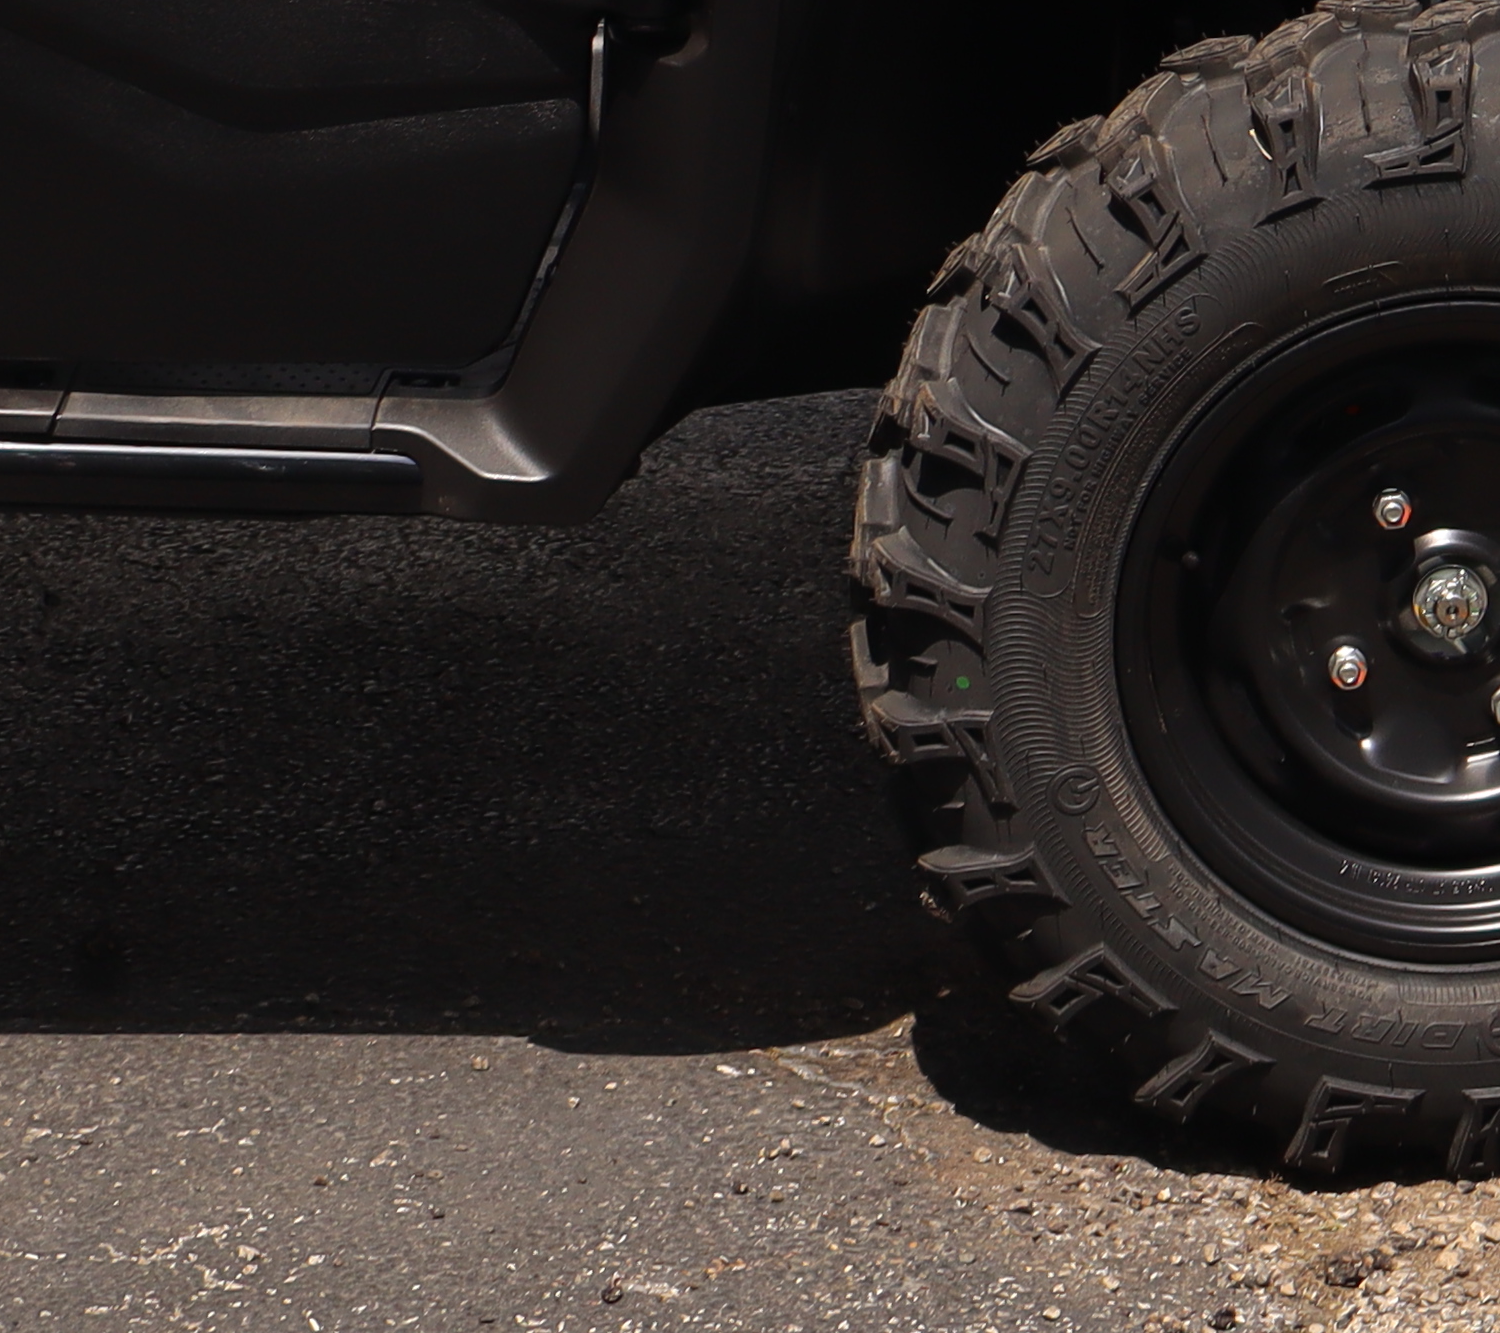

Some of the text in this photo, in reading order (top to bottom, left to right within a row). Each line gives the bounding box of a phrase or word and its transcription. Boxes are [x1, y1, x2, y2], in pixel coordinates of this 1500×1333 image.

[1063, 343, 1194, 551] NOT FOR HIGHWAY SERVICE
[1080, 821, 1465, 1052] DIRT MASTER
